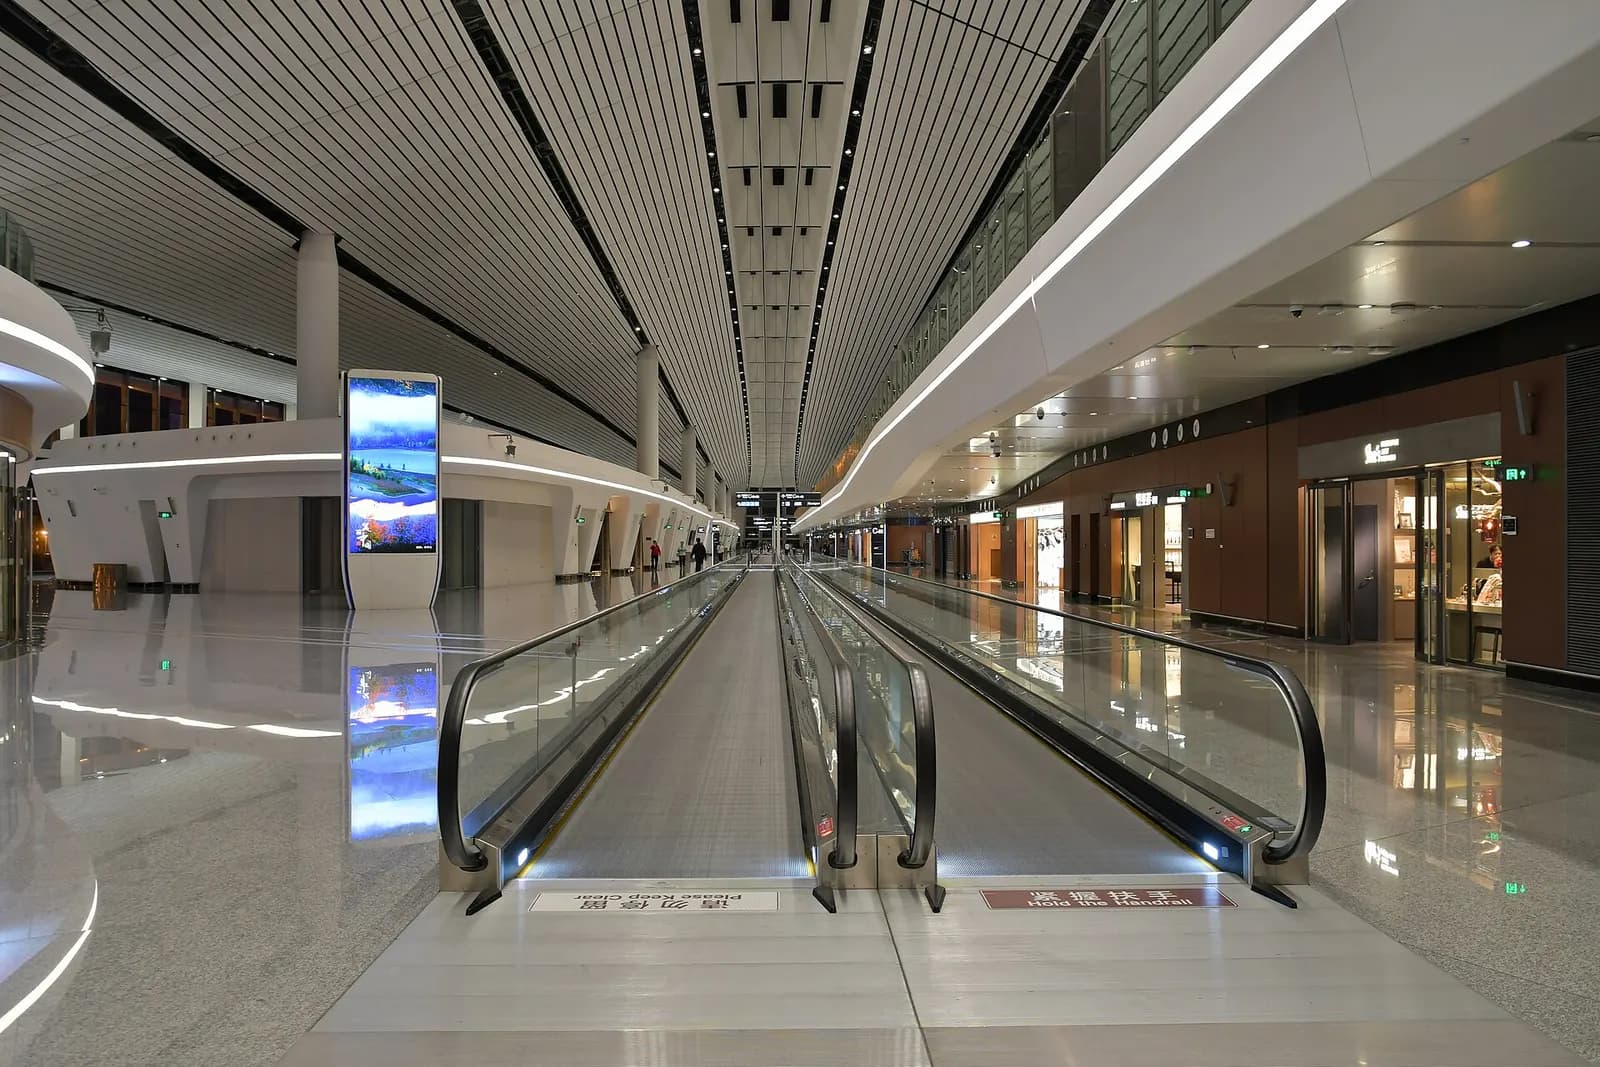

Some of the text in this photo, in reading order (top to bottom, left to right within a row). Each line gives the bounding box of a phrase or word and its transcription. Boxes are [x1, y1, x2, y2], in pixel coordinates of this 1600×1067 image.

[1030, 890, 1178, 901] 紧握扶手
[580, 900, 729, 909] 请勿停留
